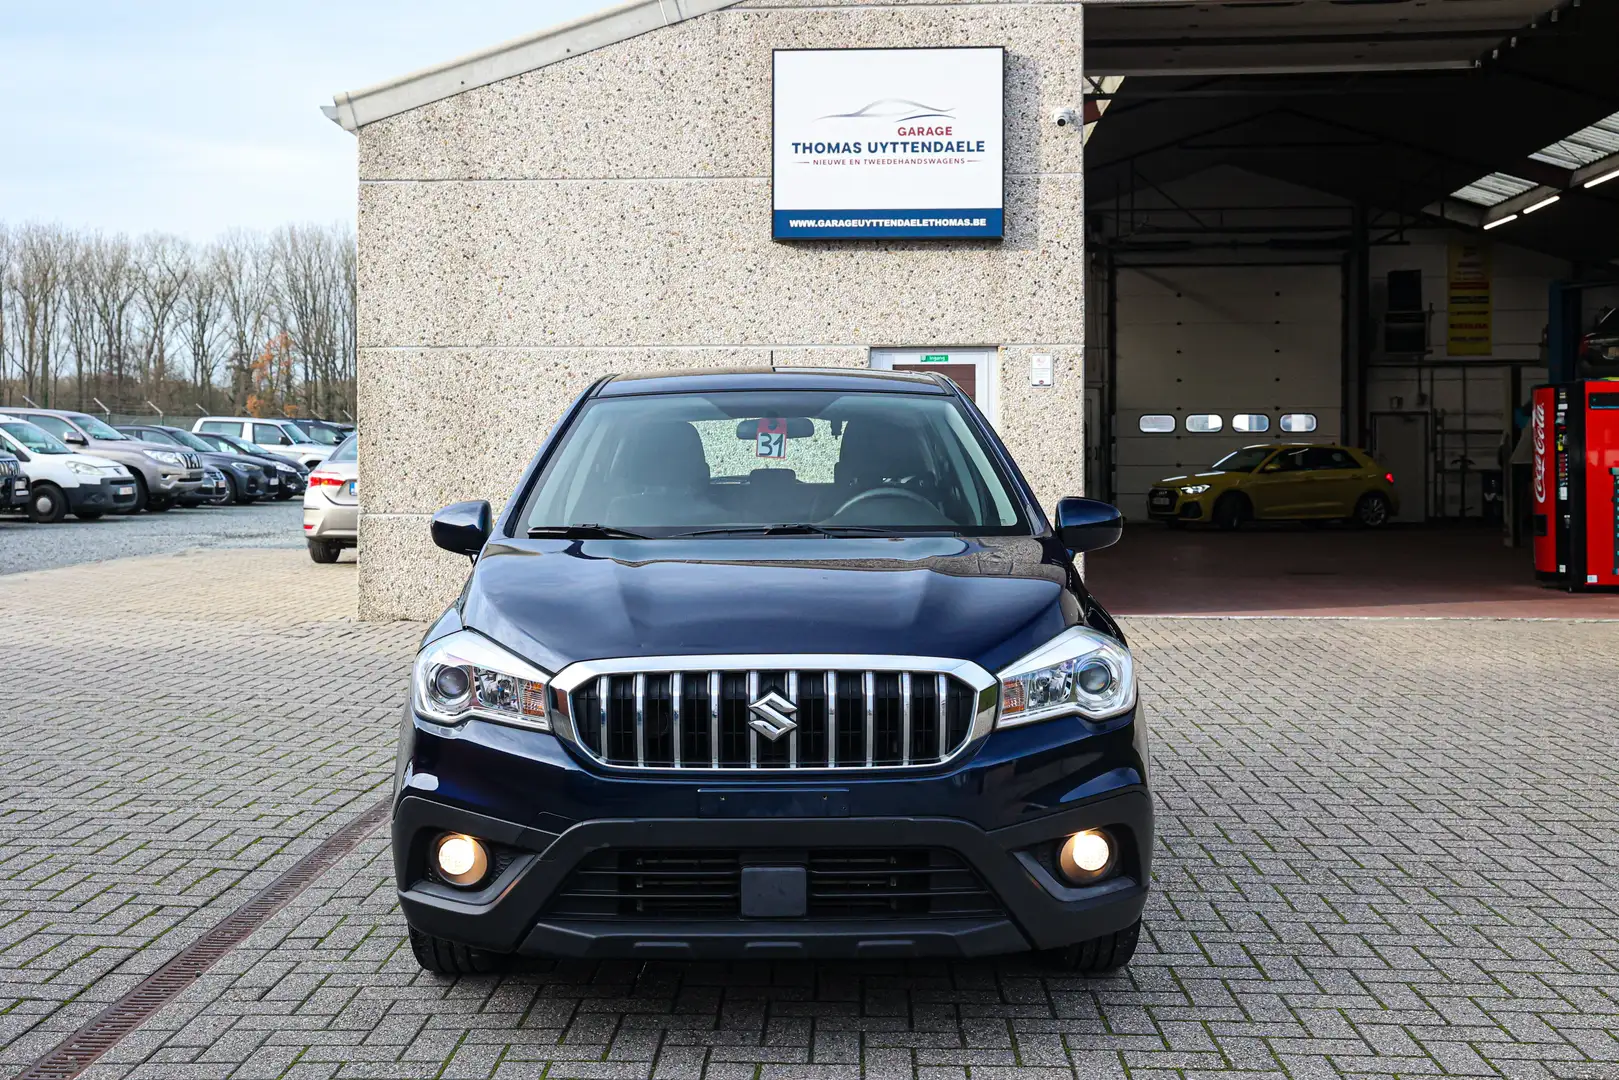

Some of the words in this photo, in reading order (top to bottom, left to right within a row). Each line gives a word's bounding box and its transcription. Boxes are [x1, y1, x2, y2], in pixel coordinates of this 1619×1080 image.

[898, 126, 952, 136] GARAGE
[792, 142, 862, 154] THOMAS
[868, 141, 985, 153] UYTTENDAELE
[790, 218, 986, 227] WWW.GARAGEUYTTENDAELETHOMAS.BE
[759, 433, 784, 457] 31
